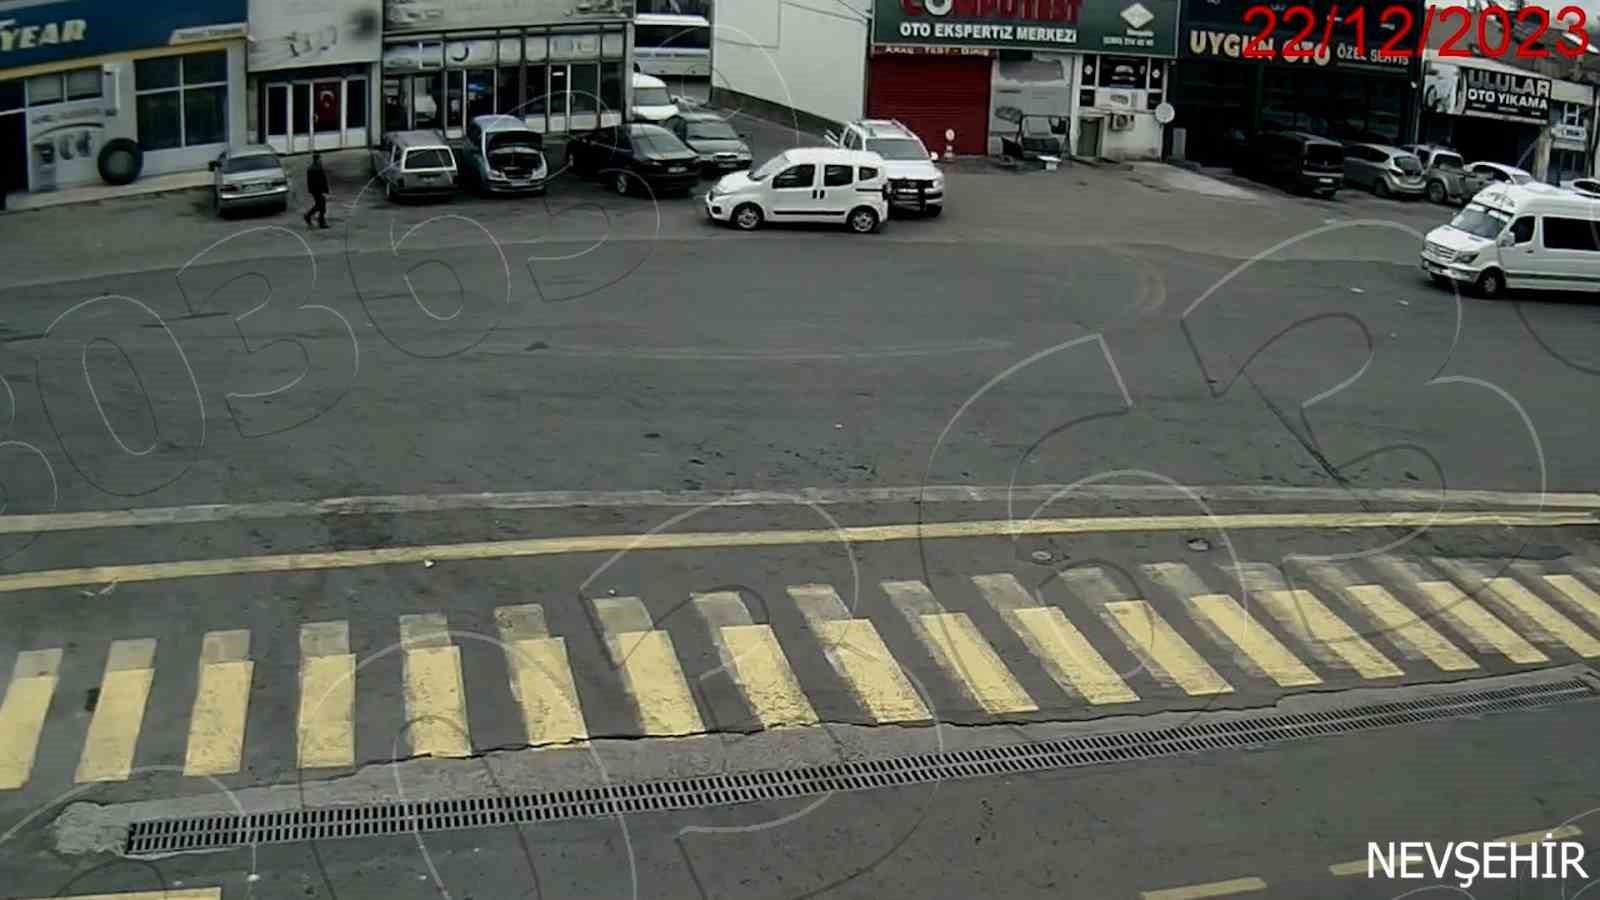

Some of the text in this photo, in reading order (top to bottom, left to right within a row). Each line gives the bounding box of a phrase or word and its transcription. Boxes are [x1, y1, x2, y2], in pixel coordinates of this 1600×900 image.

[900, 22, 931, 37] OTO
[1468, 68, 1551, 98] ULULAR
[1468, 88, 1495, 103] OTO
[1497, 92, 1548, 111] YIKAMA
